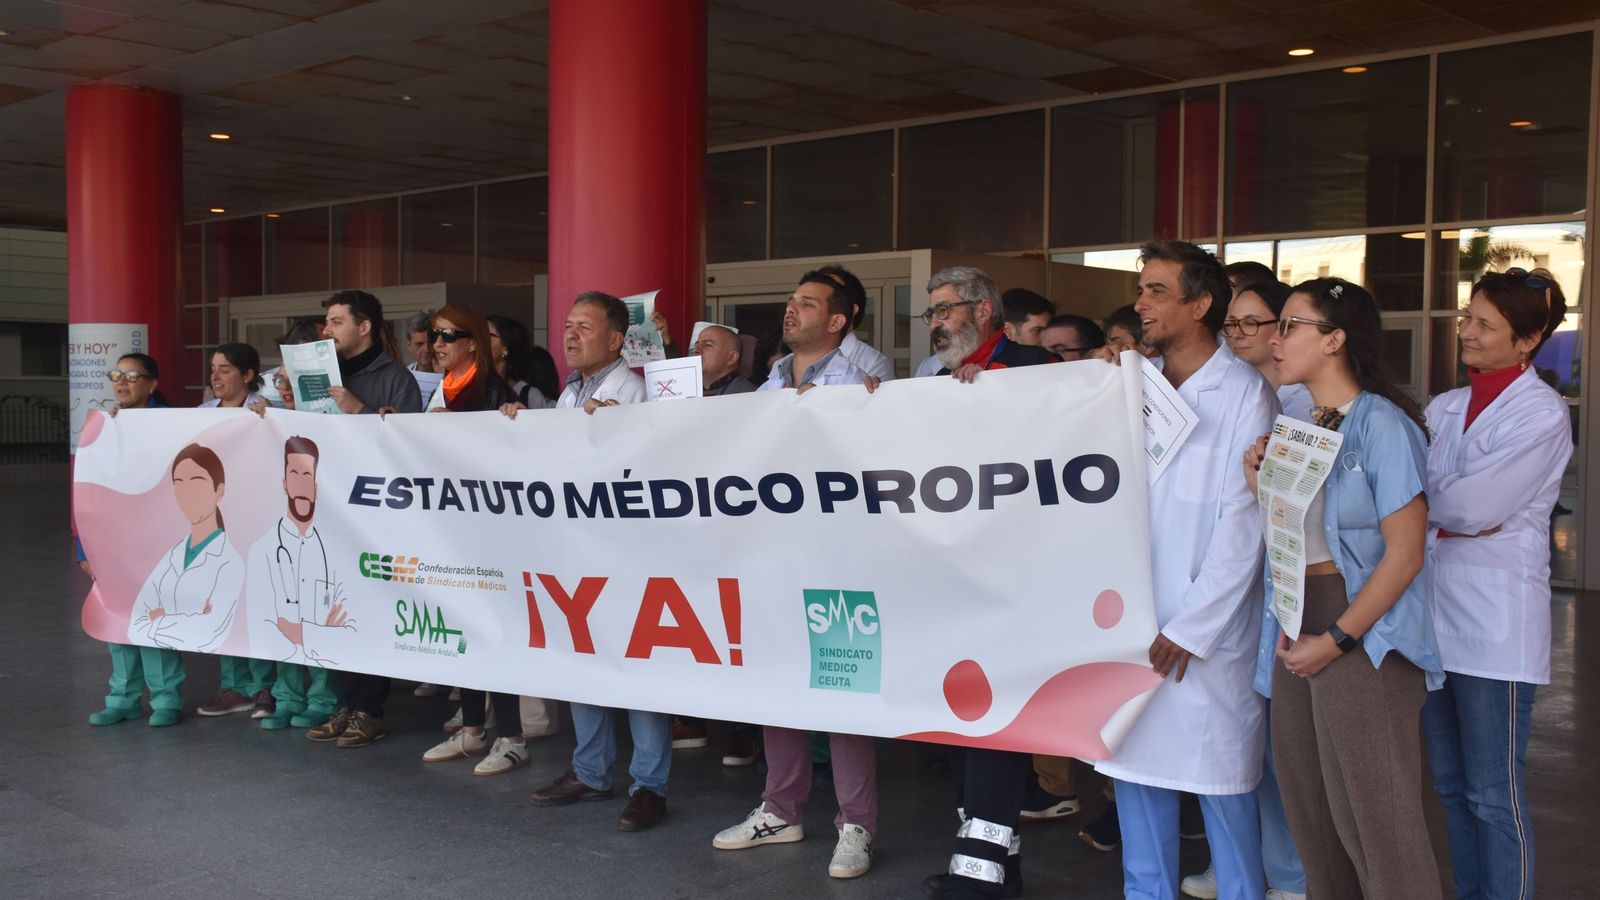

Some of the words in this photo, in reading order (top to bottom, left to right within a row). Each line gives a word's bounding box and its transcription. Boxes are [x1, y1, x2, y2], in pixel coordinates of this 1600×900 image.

[347, 474, 555, 516] ESTATUTO
[563, 468, 806, 519] MÉDICO
[815, 453, 1121, 515] PROPIO
[359, 551, 419, 584] CESM
[418, 563, 475, 575] Confederación
[476, 566, 504, 578] Española
[415, 576, 425, 585] de
[427, 576, 476, 589] Sindicatos
[478, 580, 507, 592] Médicos
[395, 599, 449, 645] SMA
[394, 642, 417, 652] Sindicato
[819, 647, 873, 660] SINDICATO
[819, 661, 858, 673] MEDICO
[818, 675, 851, 687] CEUTA
